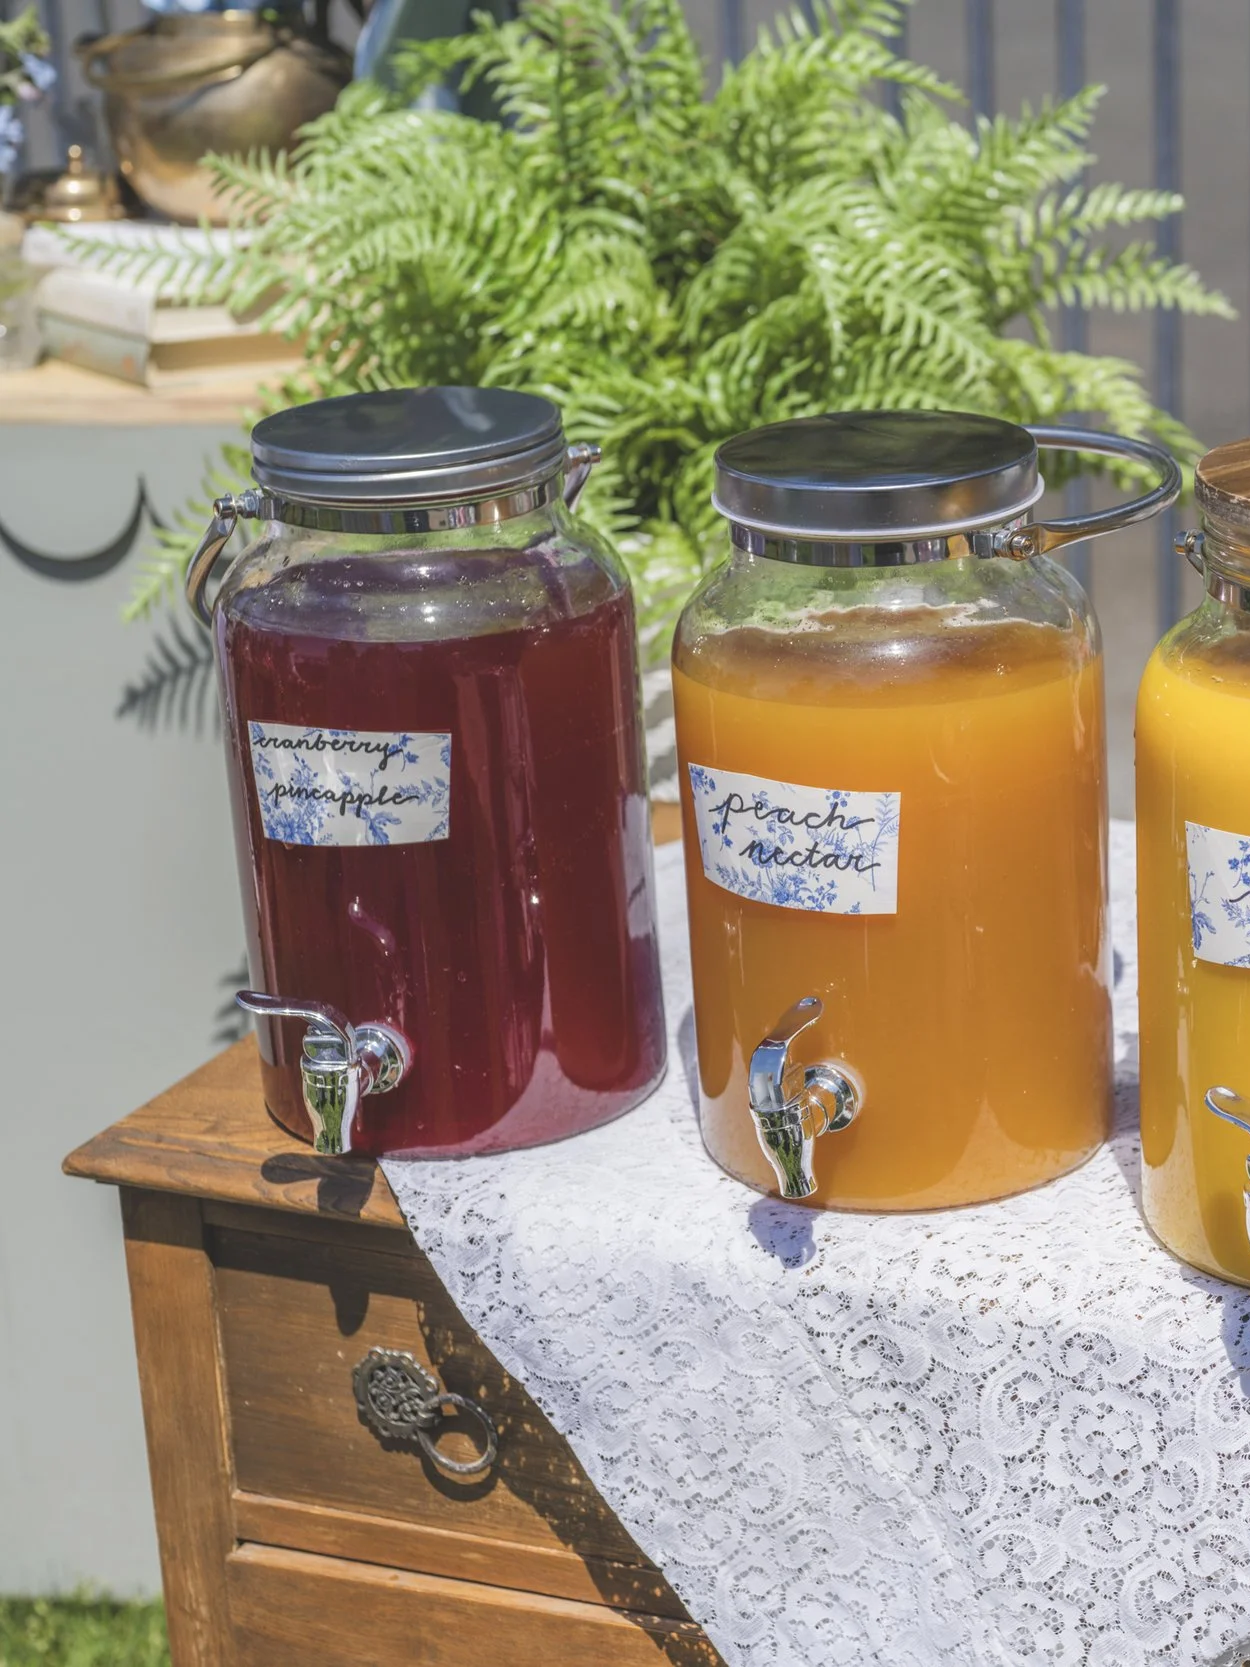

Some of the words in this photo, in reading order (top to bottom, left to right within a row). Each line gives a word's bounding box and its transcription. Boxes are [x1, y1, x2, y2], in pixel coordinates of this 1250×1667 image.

[252, 733, 404, 771] cranberry
[268, 776, 420, 818] pineapple
[708, 792, 875, 835] peach
[739, 840, 881, 873] nectar
